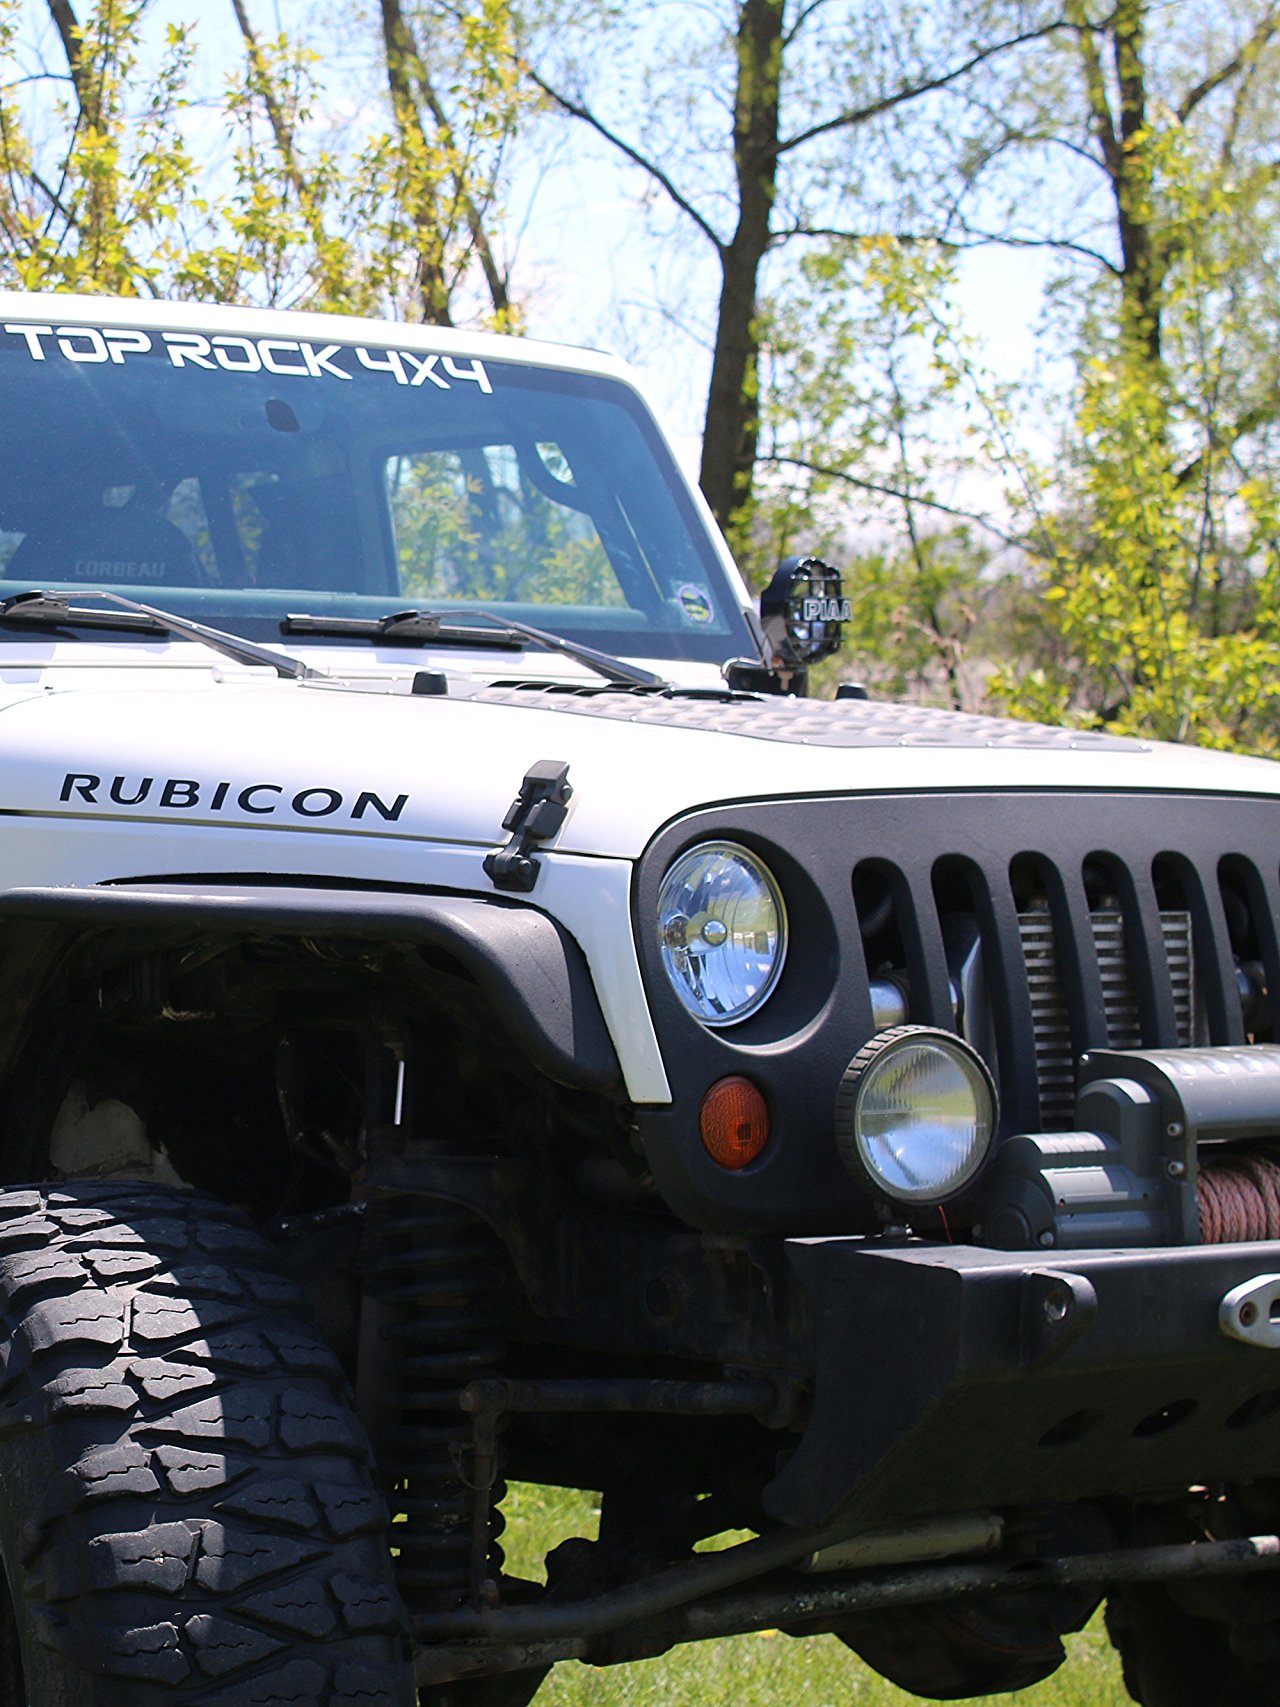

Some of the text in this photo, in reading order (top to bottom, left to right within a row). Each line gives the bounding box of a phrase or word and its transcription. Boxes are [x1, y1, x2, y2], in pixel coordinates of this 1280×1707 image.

[4, 324, 493, 394] TOP ROCK 4X4
[75, 561, 165, 578] CORBEAU
[803, 599, 852, 621] PIAA
[59, 773, 410, 822] RUBICON
